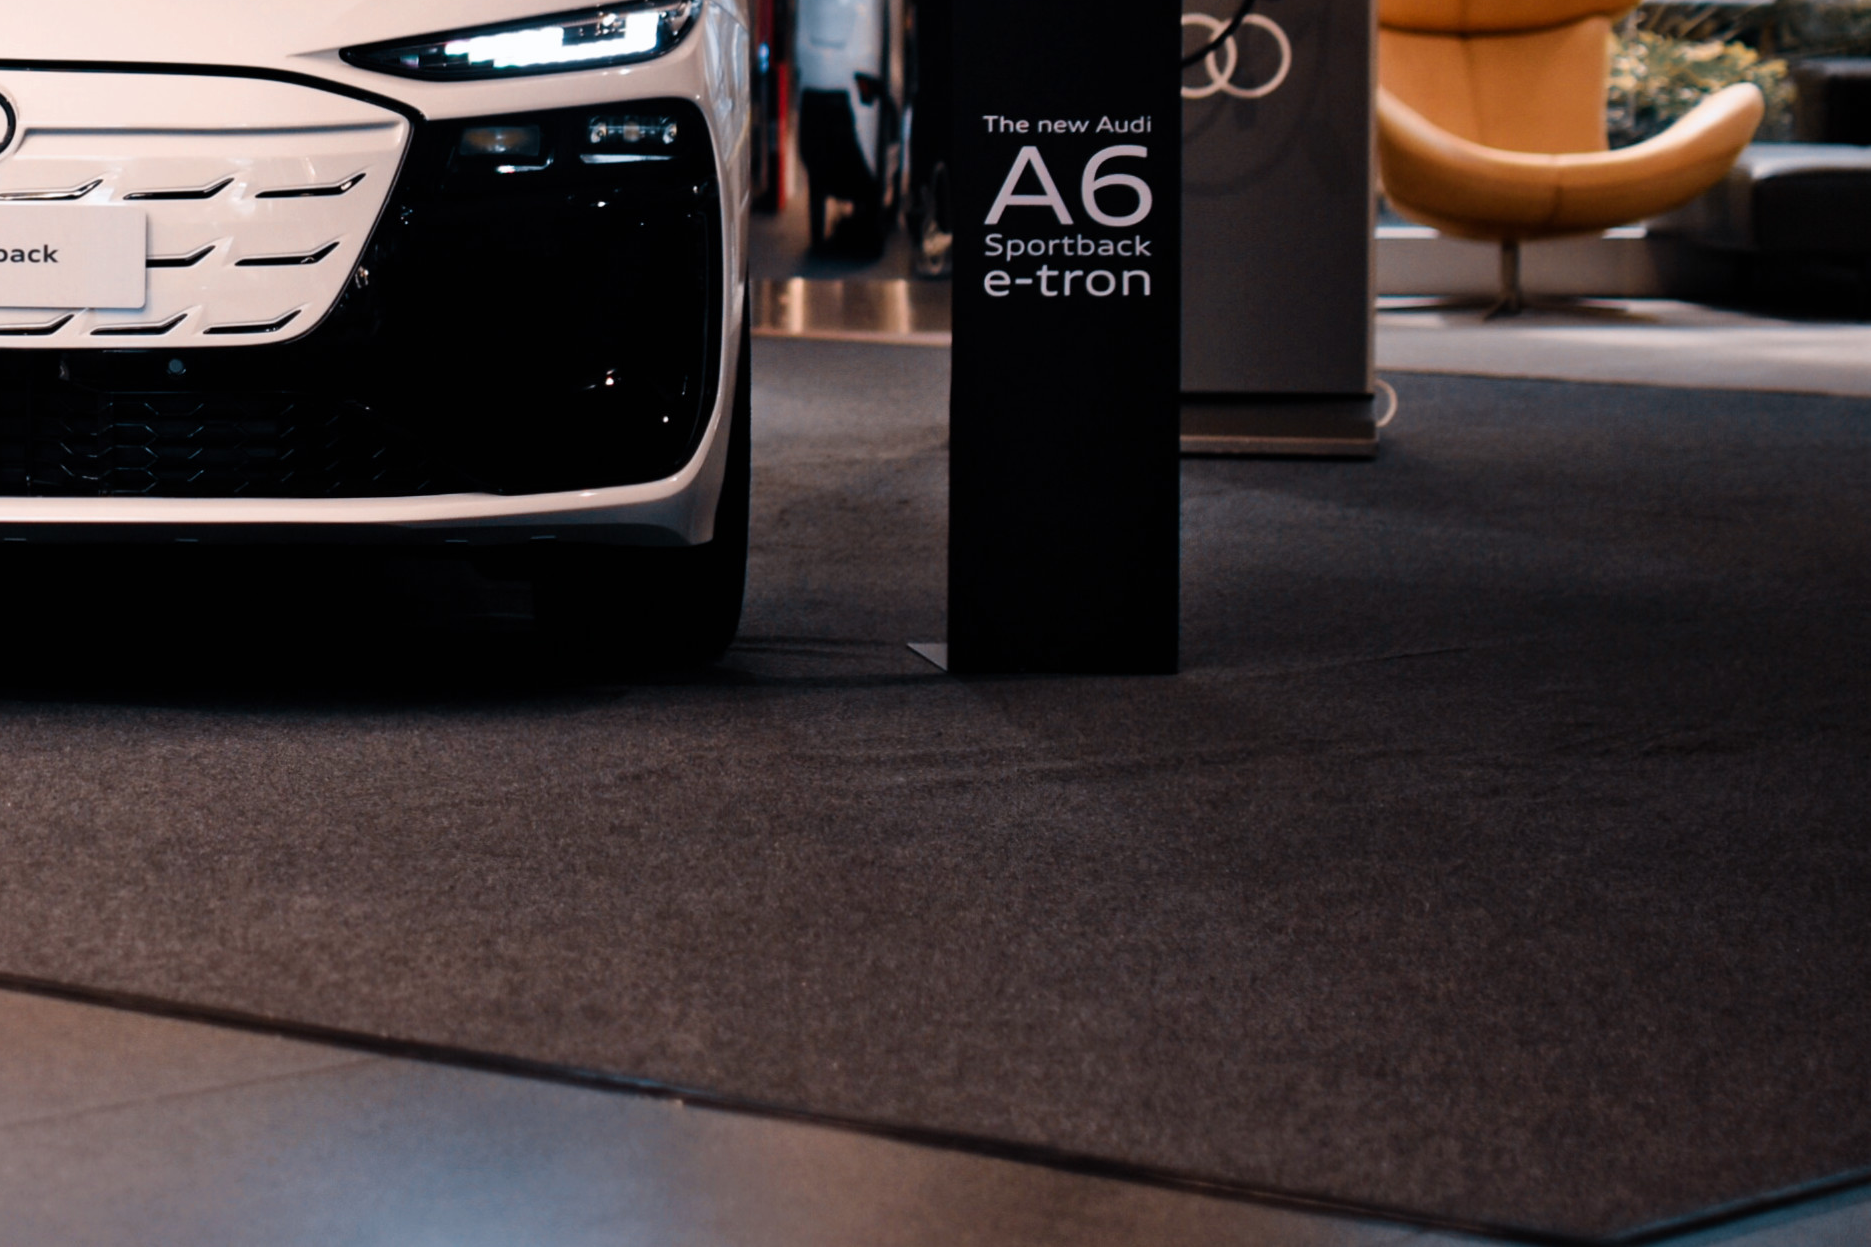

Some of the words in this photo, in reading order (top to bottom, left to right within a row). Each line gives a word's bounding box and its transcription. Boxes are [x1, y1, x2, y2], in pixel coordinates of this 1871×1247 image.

[983, 115, 1029, 134] The
[1037, 120, 1089, 134] new
[1095, 115, 1152, 134] Audi
[984, 144, 1152, 227] A6
[984, 233, 1152, 261] Sportback
[984, 264, 1151, 297] e-tron
